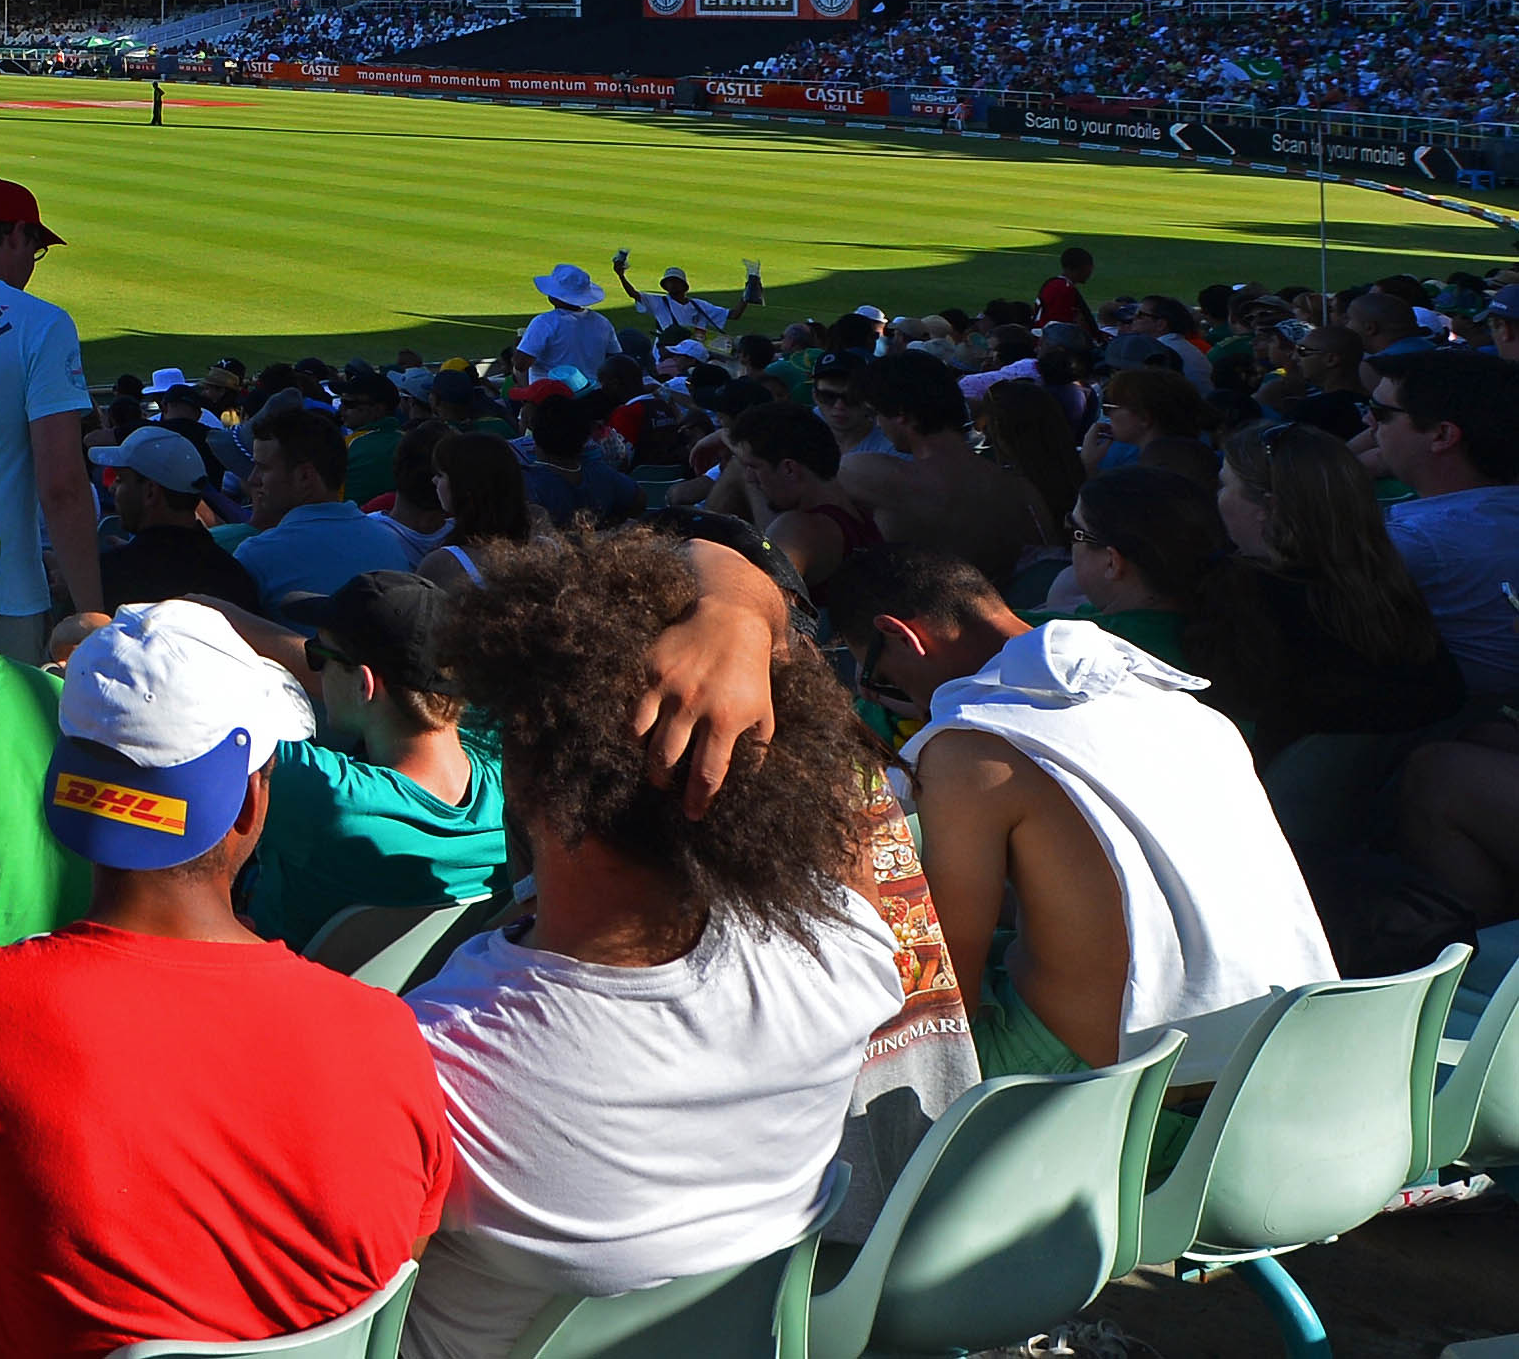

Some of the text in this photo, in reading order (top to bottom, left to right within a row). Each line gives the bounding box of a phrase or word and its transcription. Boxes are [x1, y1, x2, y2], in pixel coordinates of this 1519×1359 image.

[301, 64, 340, 77] CASTLE
[357, 70, 422, 84] momentum
[429, 74, 501, 88] momentum
[509, 79, 586, 91] momentum
[706, 81, 763, 98] CASTLE
[805, 87, 865, 105] CASTLE
[724, 97, 746, 105] LAGER
[911, 93, 957, 104] NASHUA
[824, 104, 847, 112] LAGER
[1025, 112, 1161, 140] Scan to your mobile
[1272, 133, 1307, 154] Scan
[1327, 143, 1358, 161] your
[1361, 147, 1406, 166] mobile
[64, 780, 164, 824] DHL
